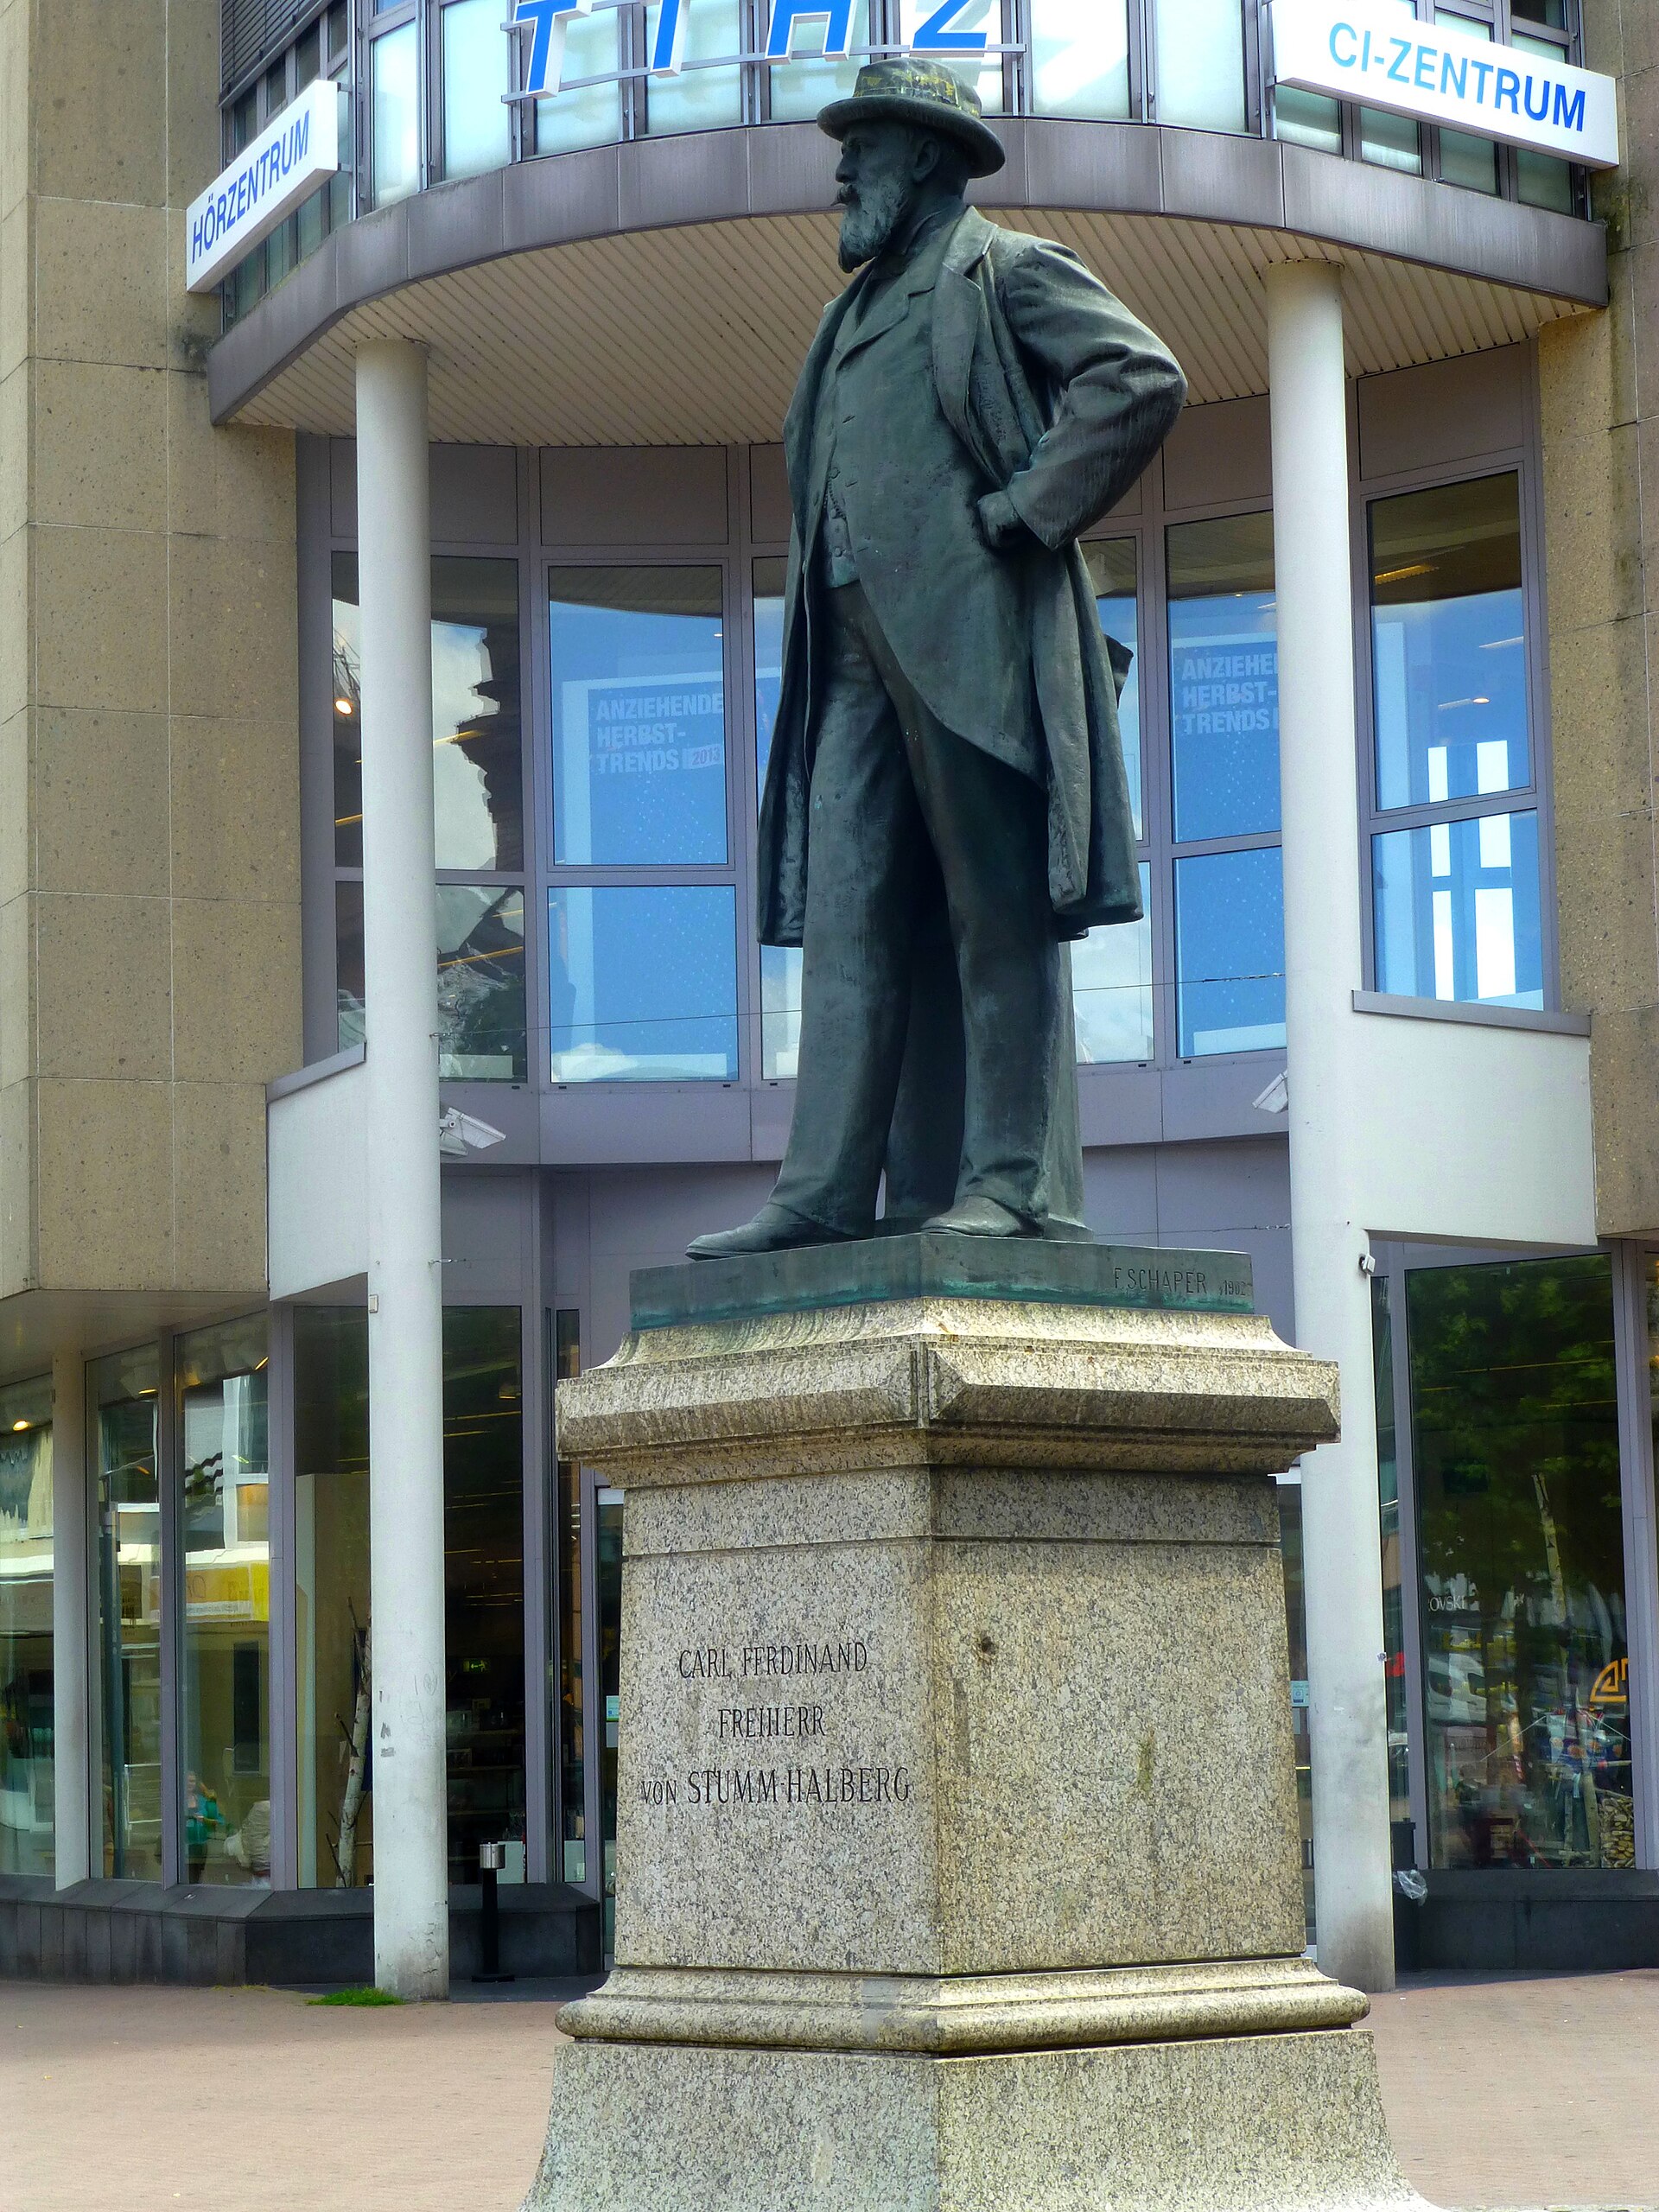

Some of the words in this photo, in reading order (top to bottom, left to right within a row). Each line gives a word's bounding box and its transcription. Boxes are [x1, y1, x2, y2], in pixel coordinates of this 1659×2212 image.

[1328, 22, 1586, 132] CI-ZENTRUM
[191, 109, 310, 264] HÖRZENTRUM
[595, 692, 723, 721] ANZIEHENDE
[1182, 681, 1277, 707] HERBST-
[596, 722, 686, 748] HERBST-
[1182, 709, 1269, 734] TRENDS
[596, 748, 679, 774] TRENDS
[691, 746, 721, 766] 2013
[678, 1648, 732, 1679] CARL
[719, 1706, 826, 1738] FREIHERR
